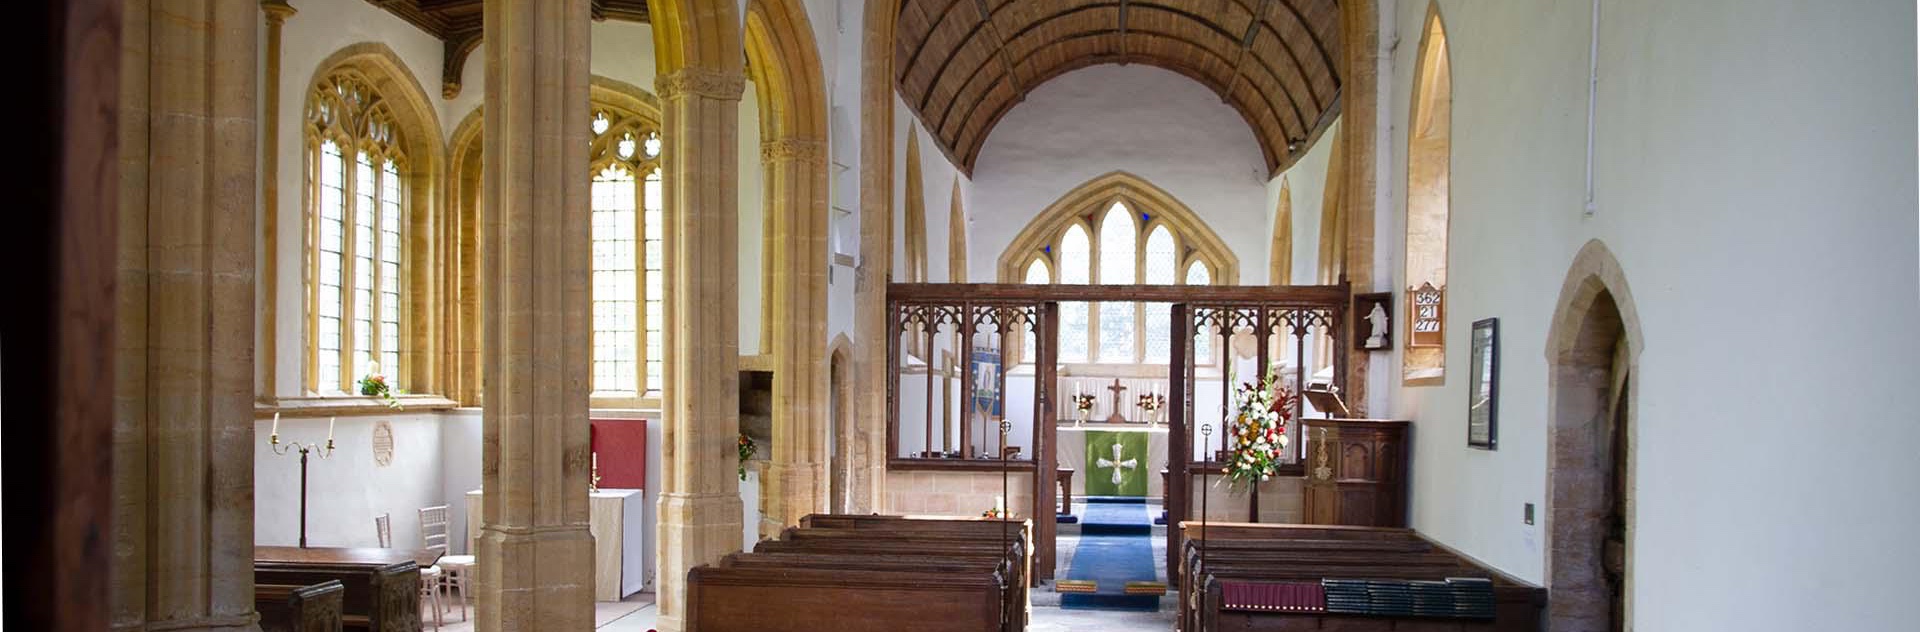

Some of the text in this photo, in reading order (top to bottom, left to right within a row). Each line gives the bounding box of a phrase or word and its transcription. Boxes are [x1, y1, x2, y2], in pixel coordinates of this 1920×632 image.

[1417, 292, 1440, 304] 362
[1420, 305, 1434, 317] 21
[1416, 319, 1439, 331] 277
